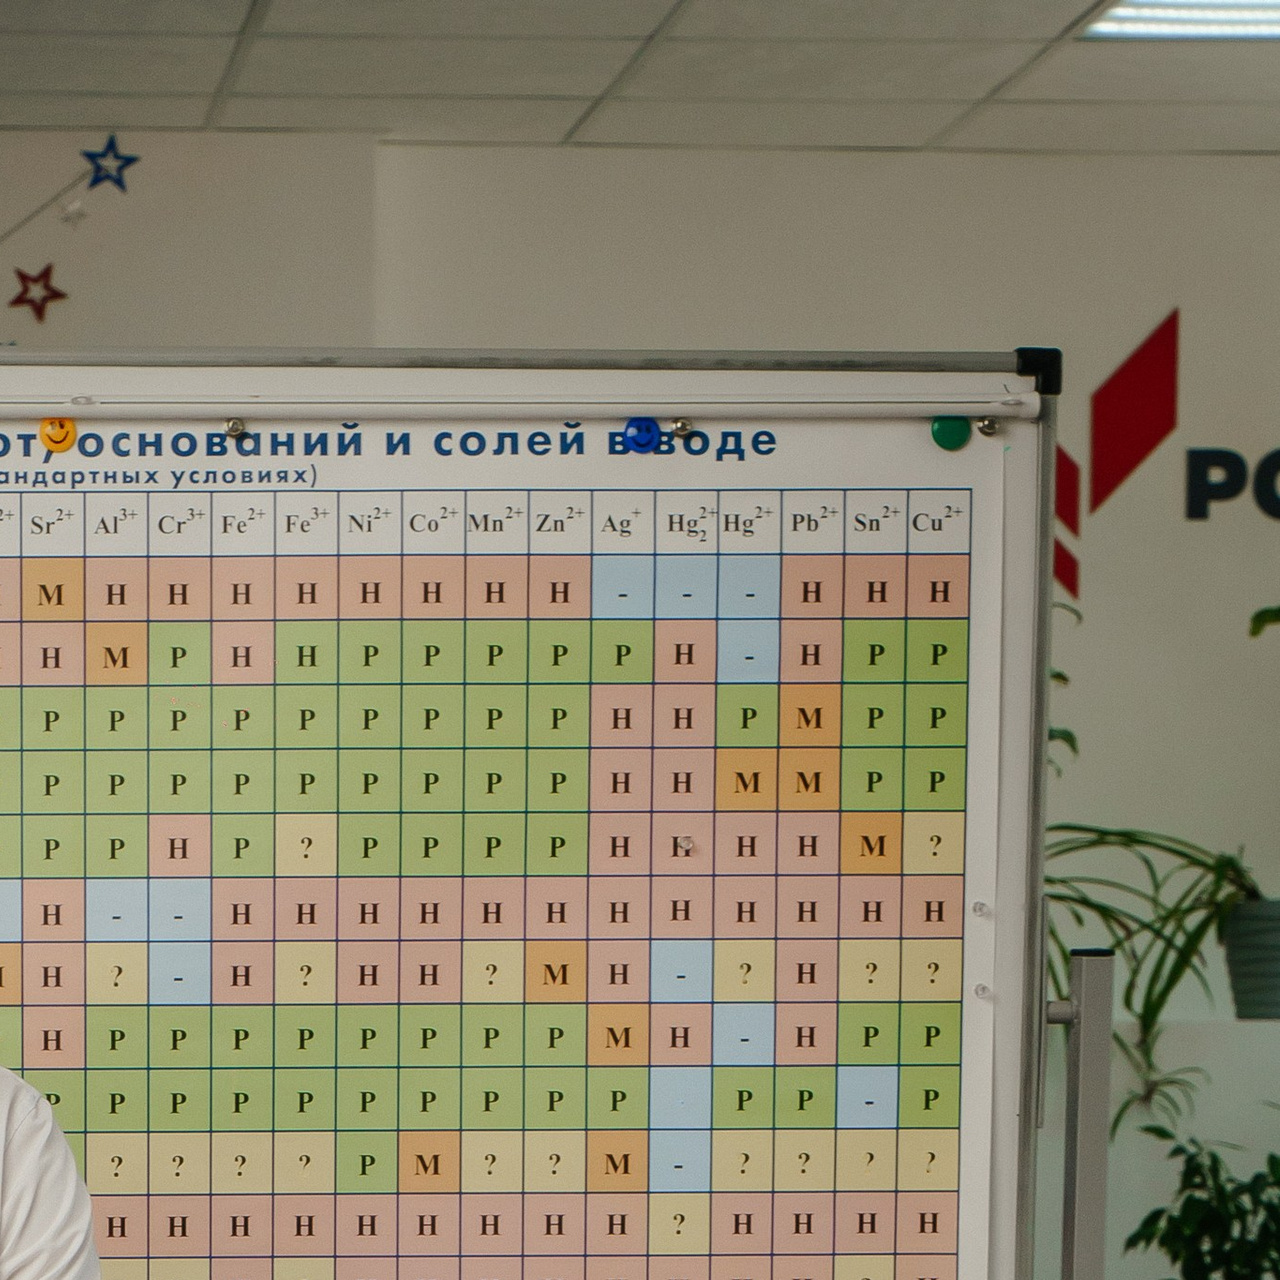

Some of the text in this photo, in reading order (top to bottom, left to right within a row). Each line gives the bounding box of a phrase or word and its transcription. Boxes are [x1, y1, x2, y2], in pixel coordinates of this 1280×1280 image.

[76, 422, 363, 459] оснований
[384, 428, 414, 457] и
[432, 421, 586, 457] солей
[658, 428, 780, 463] воде
[170, 463, 317, 490] условиях)
[39, 584, 63, 606] М
[107, 584, 126, 606] Н
[168, 583, 188, 605] Н
[298, 582, 317, 605] Н
[360, 582, 381, 604] Н
[550, 581, 570, 604] Н
[802, 581, 822, 603] Н
[867, 581, 888, 603] Н
[930, 581, 950, 603] Н
[171, 646, 187, 668] Р
[615, 644, 632, 666] Р
[44, 710, 60, 732] Р
[797, 707, 822, 729] М
[867, 707, 884, 729] Р
[109, 774, 125, 796] Р
[735, 771, 760, 793] М
[929, 771, 946, 793] Р
[169, 838, 188, 859] Н
[300, 836, 313, 859] ?
[860, 835, 886, 857] М
[42, 904, 61, 926] Н
[482, 902, 502, 924] Н
[925, 900, 944, 922] Н
[231, 962, 816, 987] Н М Н
[606, 1027, 631, 1048] М
[863, 1026, 880, 1048] Р
[171, 1089, 940, 1114] Р Р Р
[359, 1153, 630, 1176] Р М М
[107, 1213, 753, 1238] Н Н Н
